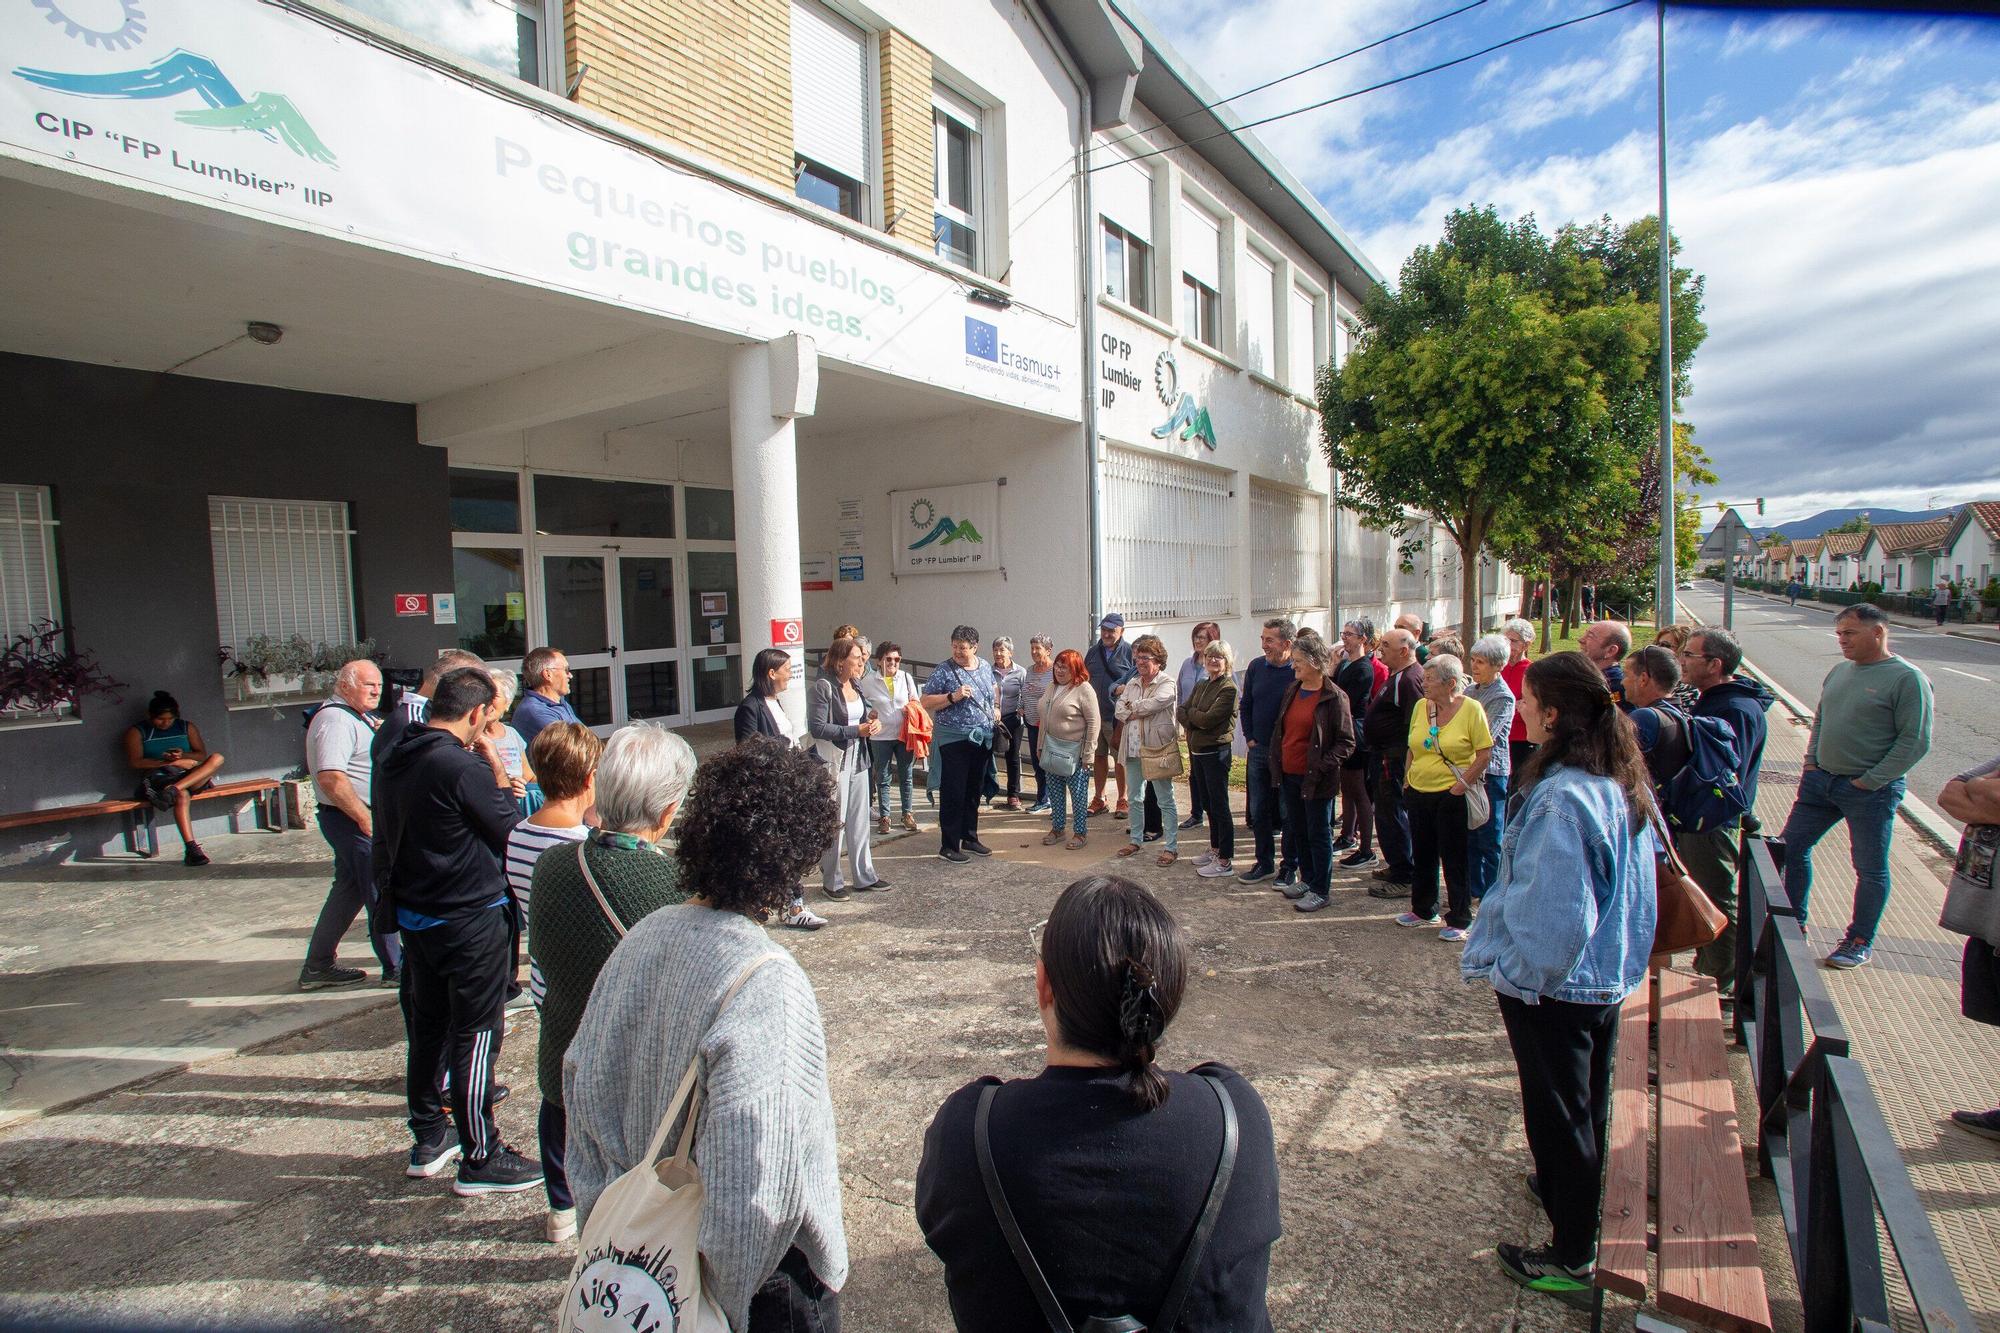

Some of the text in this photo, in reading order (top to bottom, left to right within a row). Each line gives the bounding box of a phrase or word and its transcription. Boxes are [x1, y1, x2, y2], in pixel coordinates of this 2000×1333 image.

[35, 112, 94, 141] CIP
[304, 187, 333, 207] IIP
[494, 136, 904, 314] Pequeños pueblos,
[566, 231, 872, 341] grandes ideas.
[1001, 342, 1061, 380] Erasmus+
[1101, 333, 1132, 361] CIP FP
[1101, 361, 1142, 392] Lumbier
[1101, 388, 1116, 409] IIP
[911, 557, 923, 566] CIP
[972, 554, 982, 563] IIP
